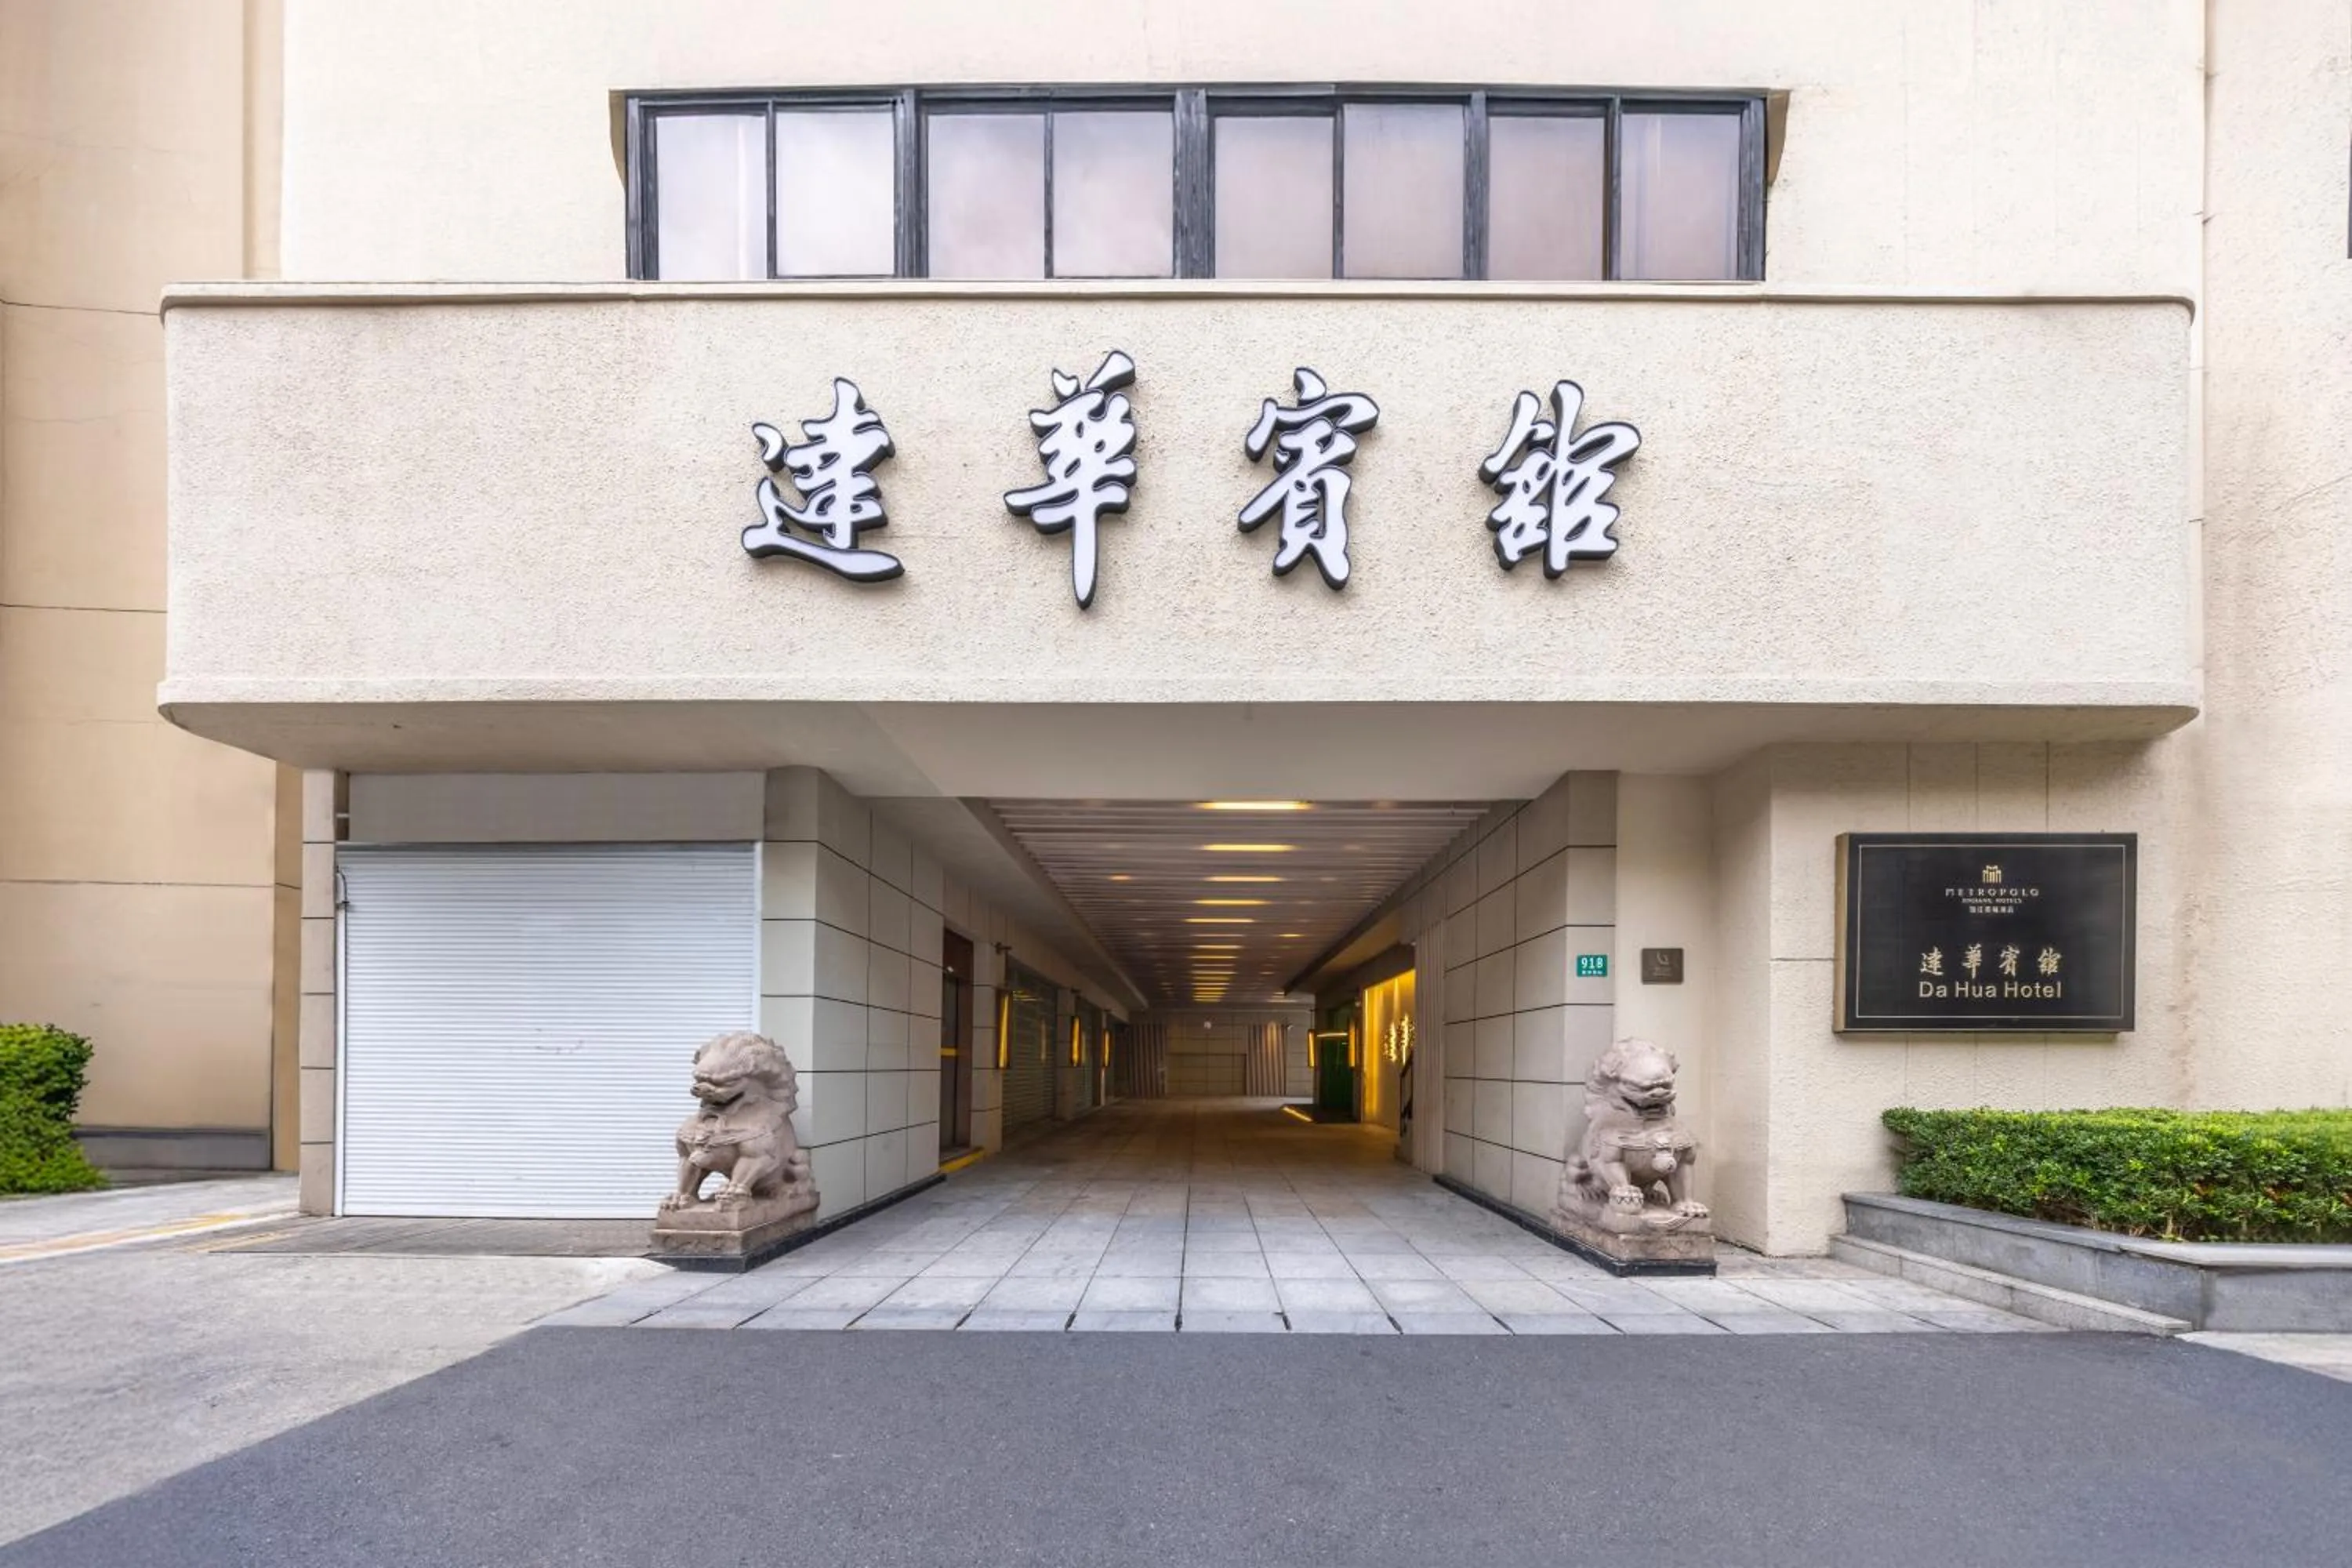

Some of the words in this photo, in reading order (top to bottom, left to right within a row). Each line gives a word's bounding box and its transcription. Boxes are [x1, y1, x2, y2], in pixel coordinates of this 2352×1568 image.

[1945, 887, 2039, 897] METROPOLO
[1581, 957, 1603, 969] 918
[1918, 981, 1947, 998] Da
[1955, 981, 1997, 998] Hua
[2004, 981, 2062, 998] Hotel
